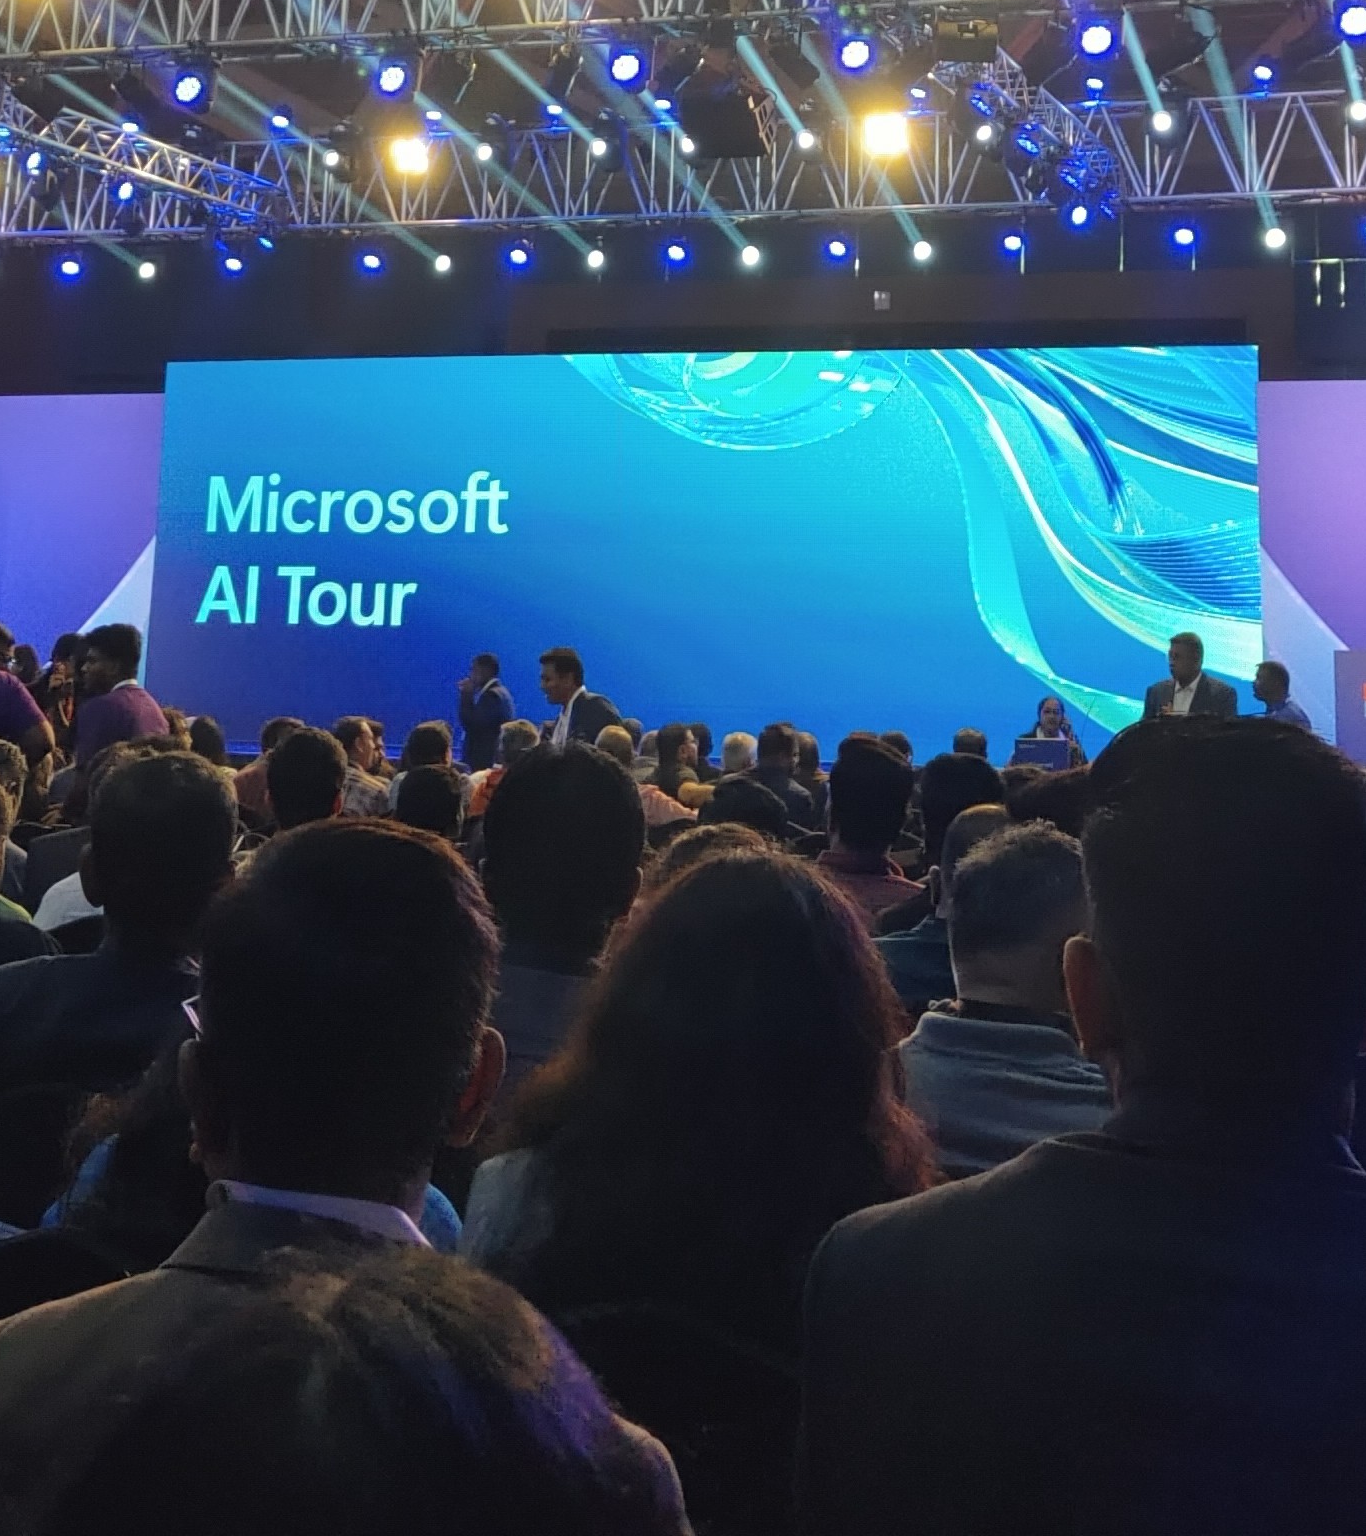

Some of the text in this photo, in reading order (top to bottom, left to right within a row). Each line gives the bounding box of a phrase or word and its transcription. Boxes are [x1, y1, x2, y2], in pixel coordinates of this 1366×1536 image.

[204, 470, 510, 536] Microsoft
[194, 565, 419, 627] AI Tour
